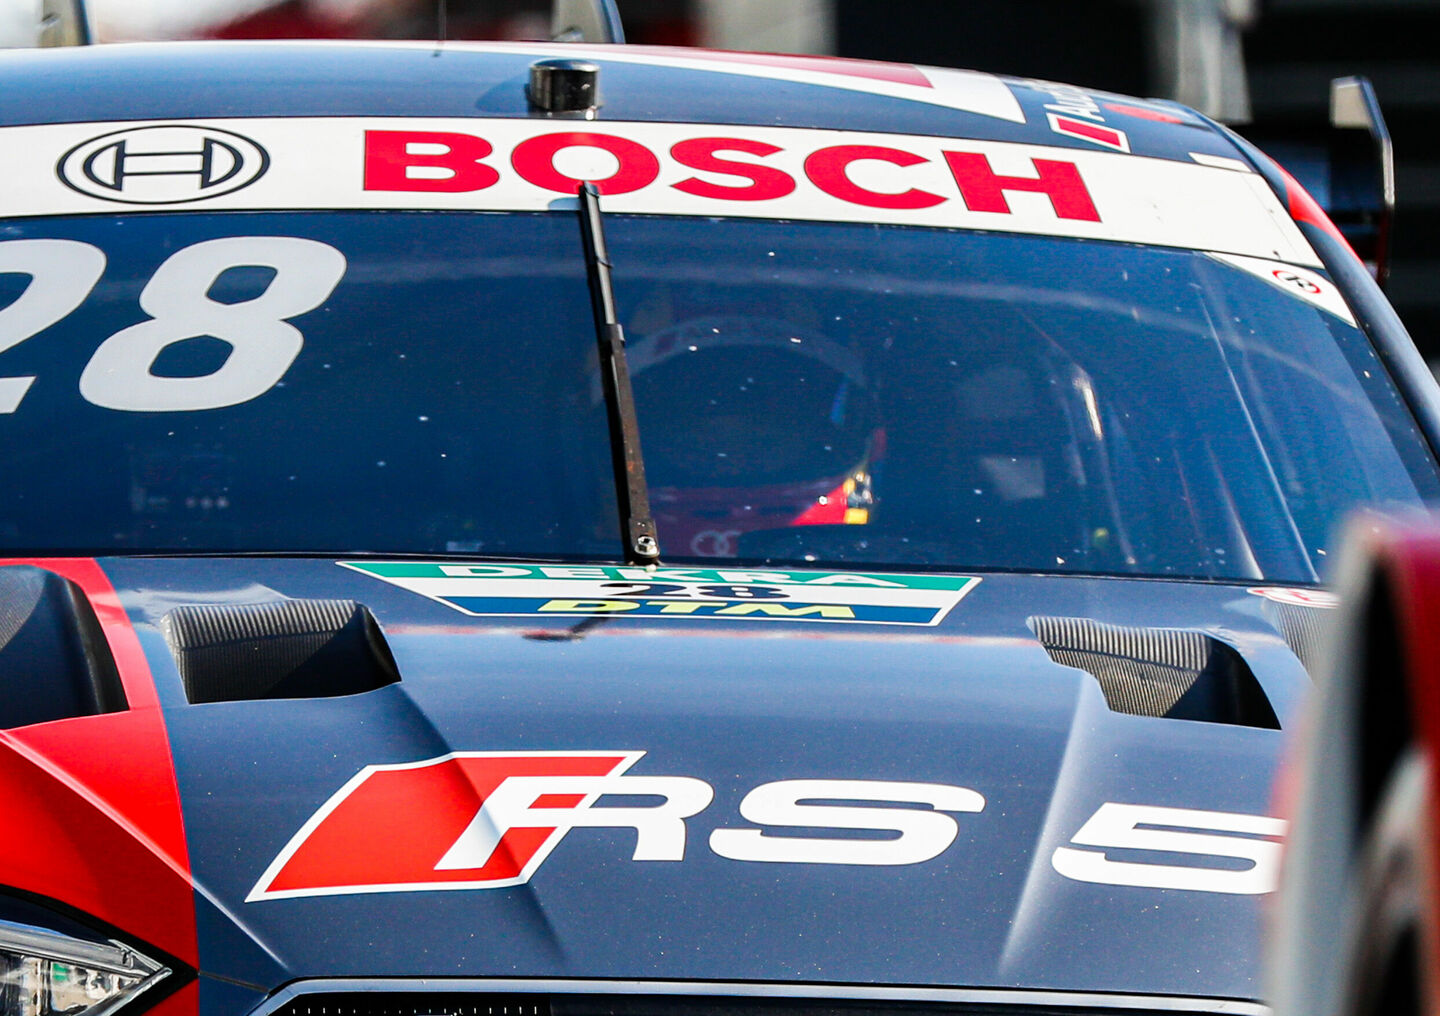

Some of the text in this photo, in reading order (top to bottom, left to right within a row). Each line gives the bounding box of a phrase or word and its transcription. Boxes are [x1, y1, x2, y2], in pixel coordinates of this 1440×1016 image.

[363, 129, 1103, 224] BOSCH
[438, 565, 910, 588] DEKRA
[600, 582, 791, 599] 28
[537, 599, 856, 619] DTM
[434, 775, 1289, 895] RS 5
